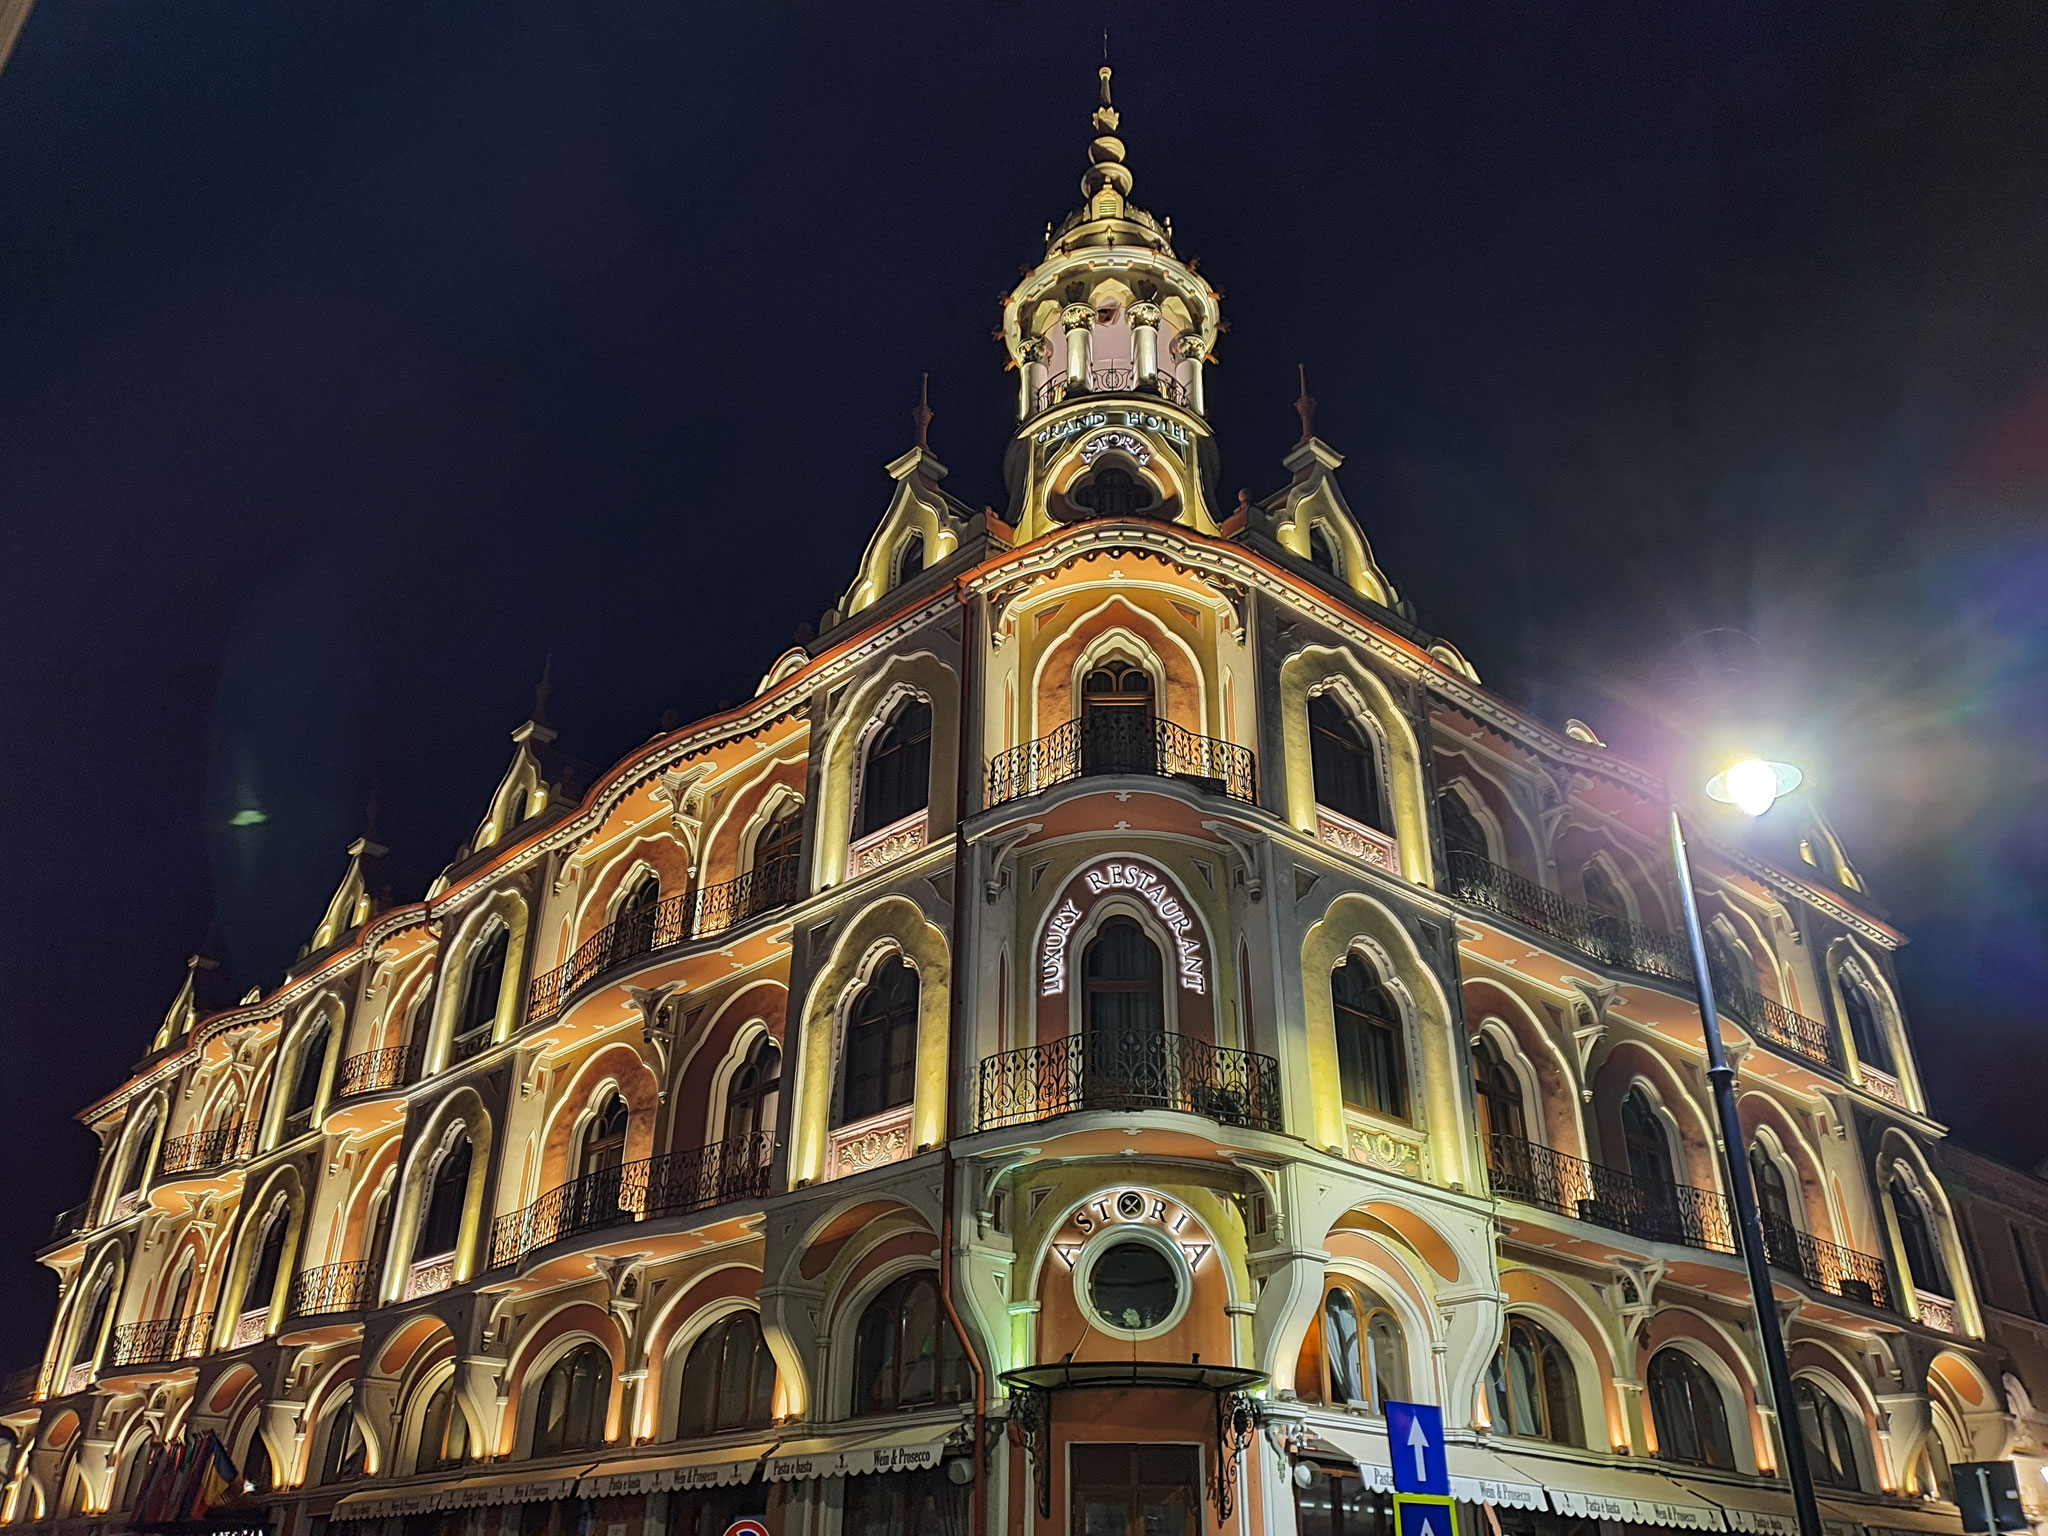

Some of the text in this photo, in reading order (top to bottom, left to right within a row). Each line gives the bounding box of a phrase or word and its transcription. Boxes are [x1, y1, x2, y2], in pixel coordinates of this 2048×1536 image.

[1037, 412, 1190, 446] GRAND HOTEL
[1080, 433, 1151, 465] ASTORIA
[1042, 864, 1206, 996] LUXURY RESTAURANT
[773, 1461, 790, 1476] Pasta
[796, 1459, 812, 1474] basta
[873, 1448, 931, 1467] Wein & Prosecco
[1479, 1481, 1532, 1503] Wein & Prosecco
